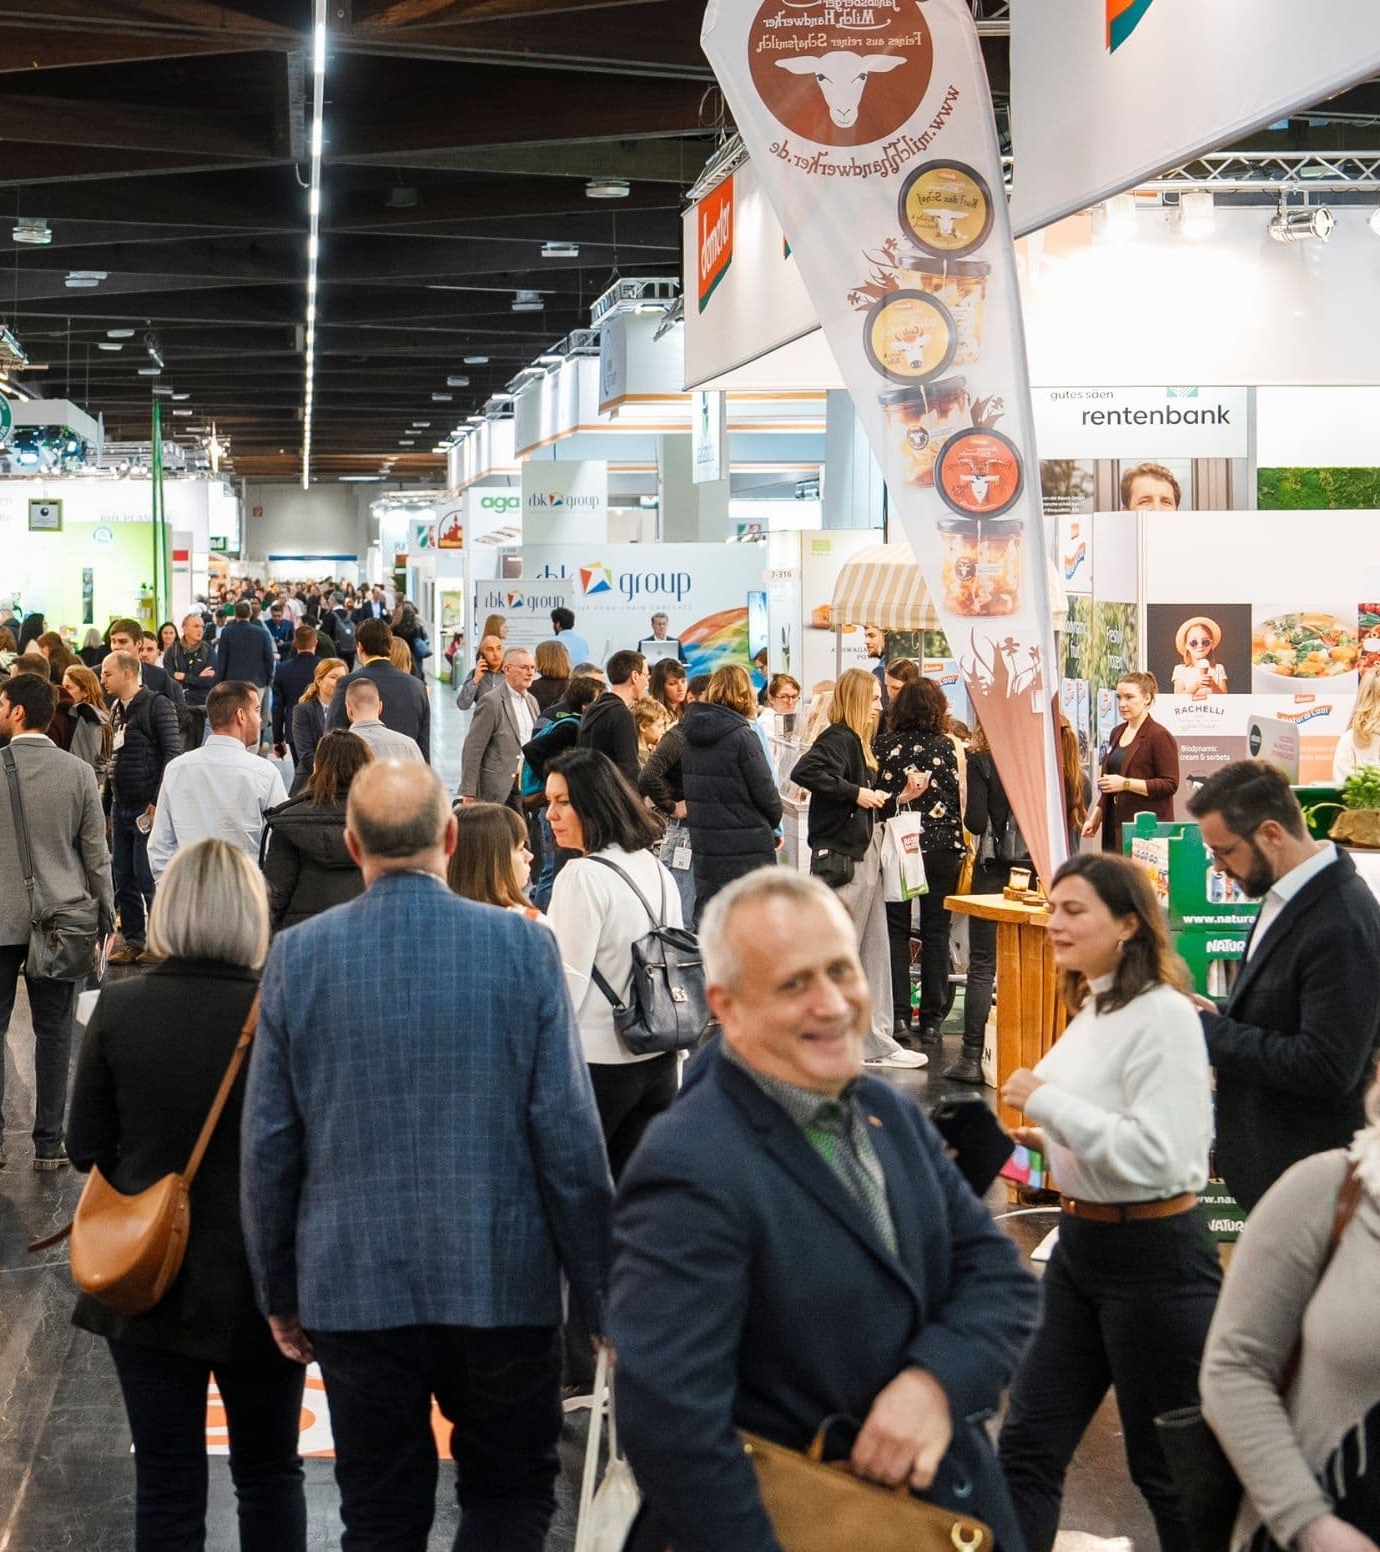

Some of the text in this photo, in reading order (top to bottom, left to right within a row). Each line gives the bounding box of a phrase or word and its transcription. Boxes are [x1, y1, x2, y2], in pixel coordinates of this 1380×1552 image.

[1050, 388, 1114, 401] gutes säen
[1081, 405, 1231, 426] rentenbank
[566, 495, 599, 510] group
[771, 570, 792, 578] 7-316
[620, 572, 692, 602] group
[527, 595, 565, 613] group
[1174, 705, 1225, 716] RACHELLI
[1181, 744, 1218, 753] Biodynamic
[1206, 753, 1230, 761] sorbets
